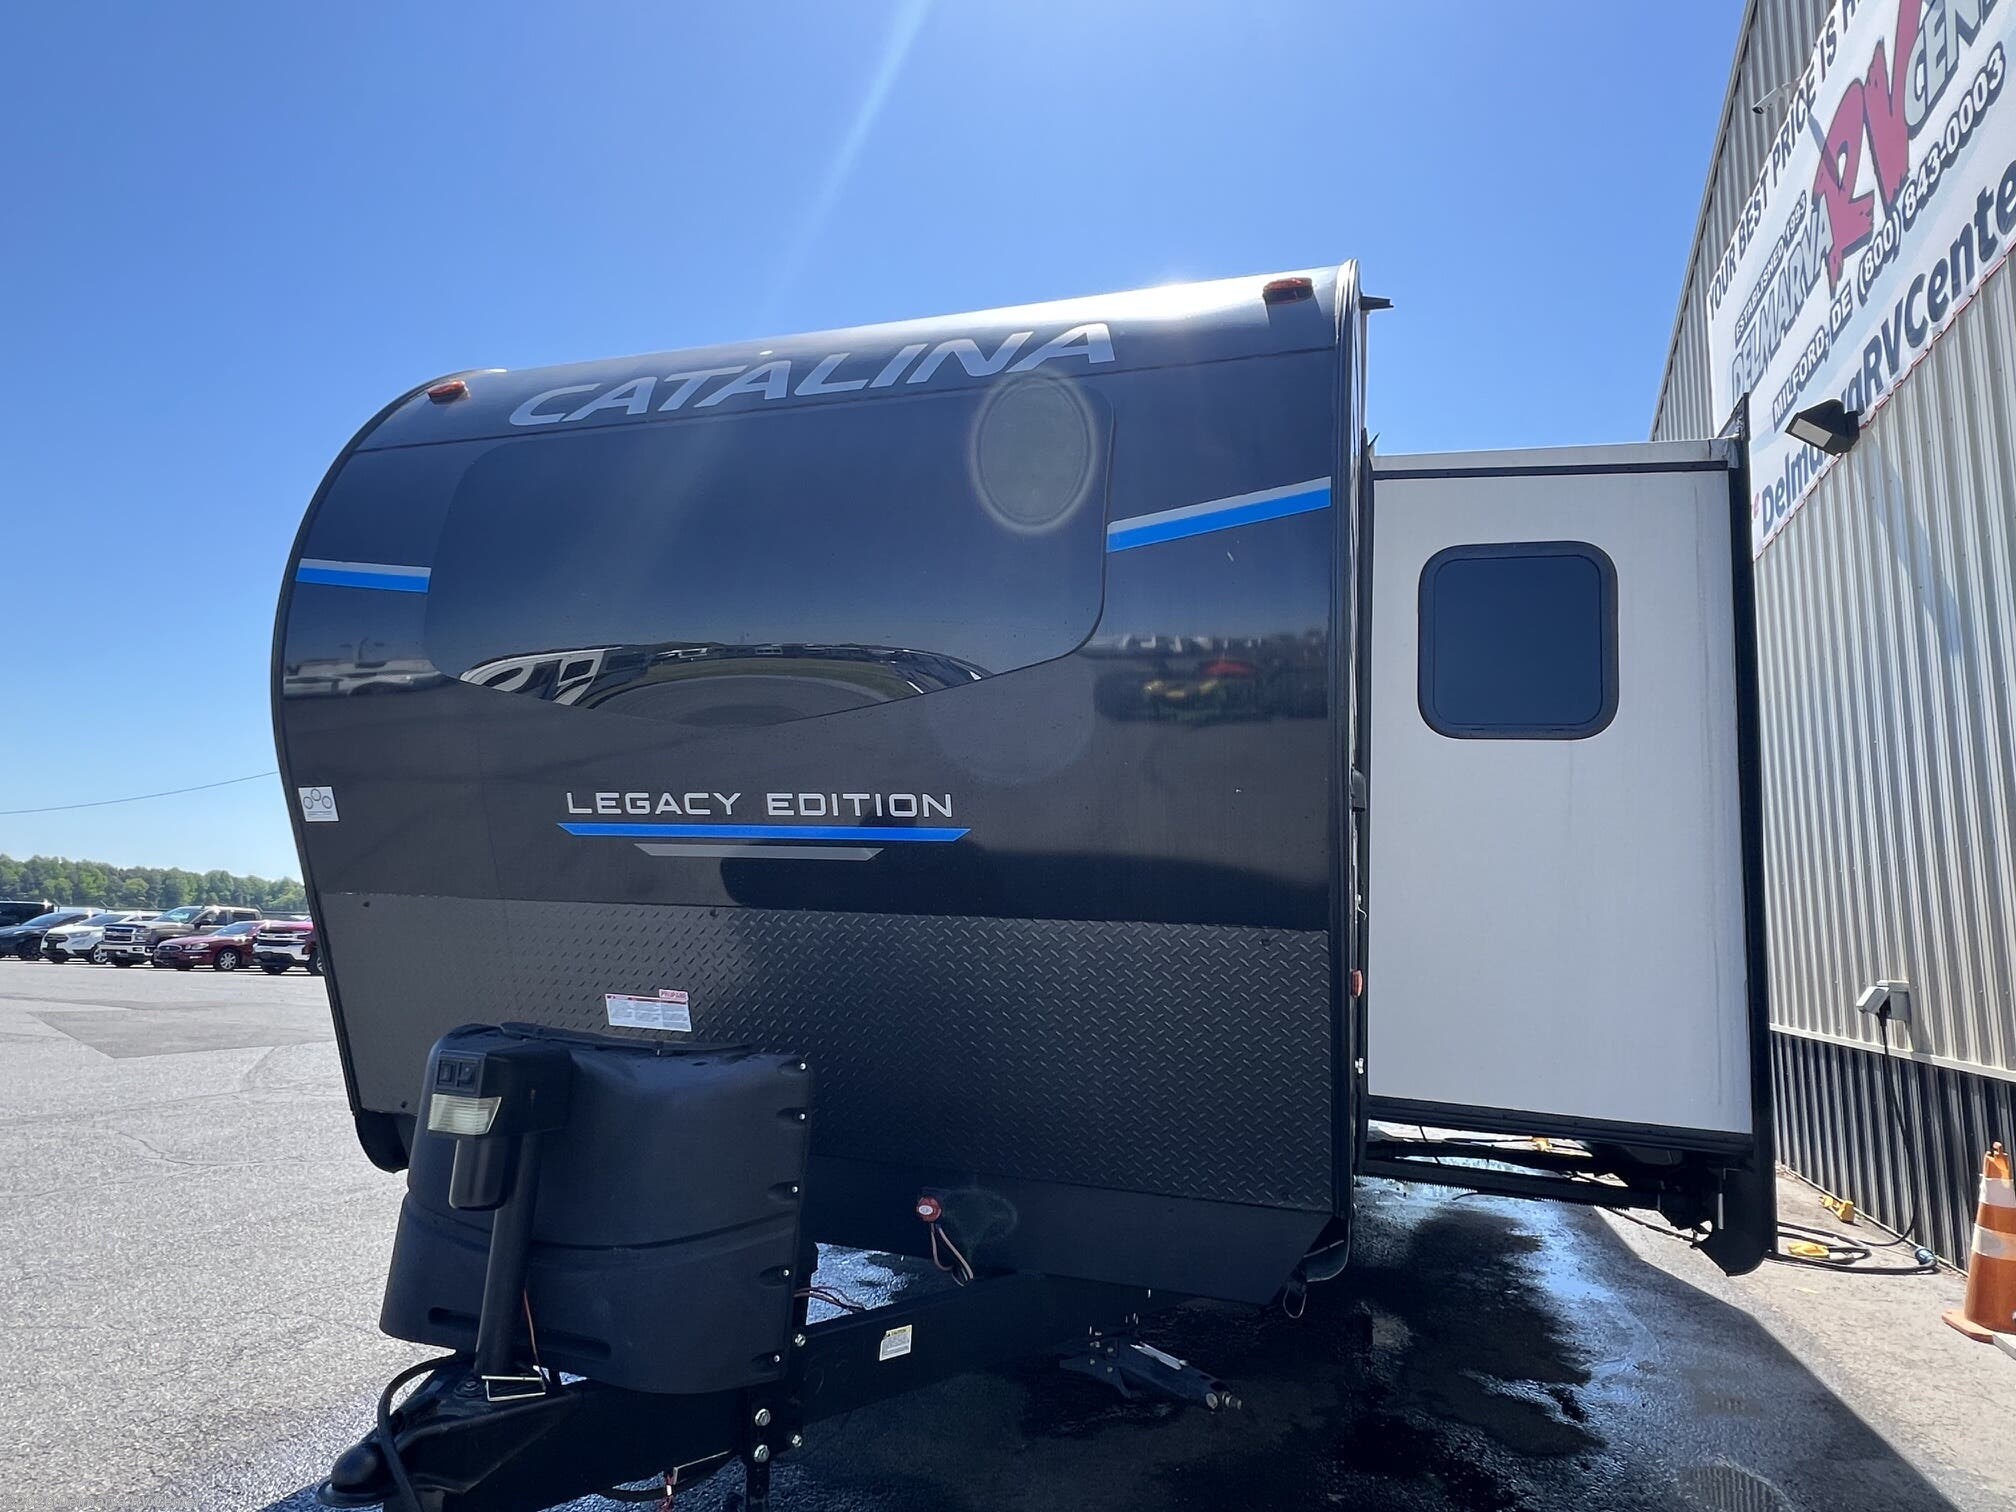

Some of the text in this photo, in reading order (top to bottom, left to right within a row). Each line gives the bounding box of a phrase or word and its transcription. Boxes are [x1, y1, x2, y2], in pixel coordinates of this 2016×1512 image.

[1709, 15, 1837, 321] YOUR BEST PRICE IS
[1732, 191, 1834, 410] DELMARVA
[1811, 0, 1922, 300] RV
[1772, 41, 2006, 433] MILFORD, DE (800) 843-0003
[509, 323, 1116, 425] CATALINA
[1735, 234, 1785, 348] ESTABLISHED
[566, 792, 953, 818] LEGACY EDITION
